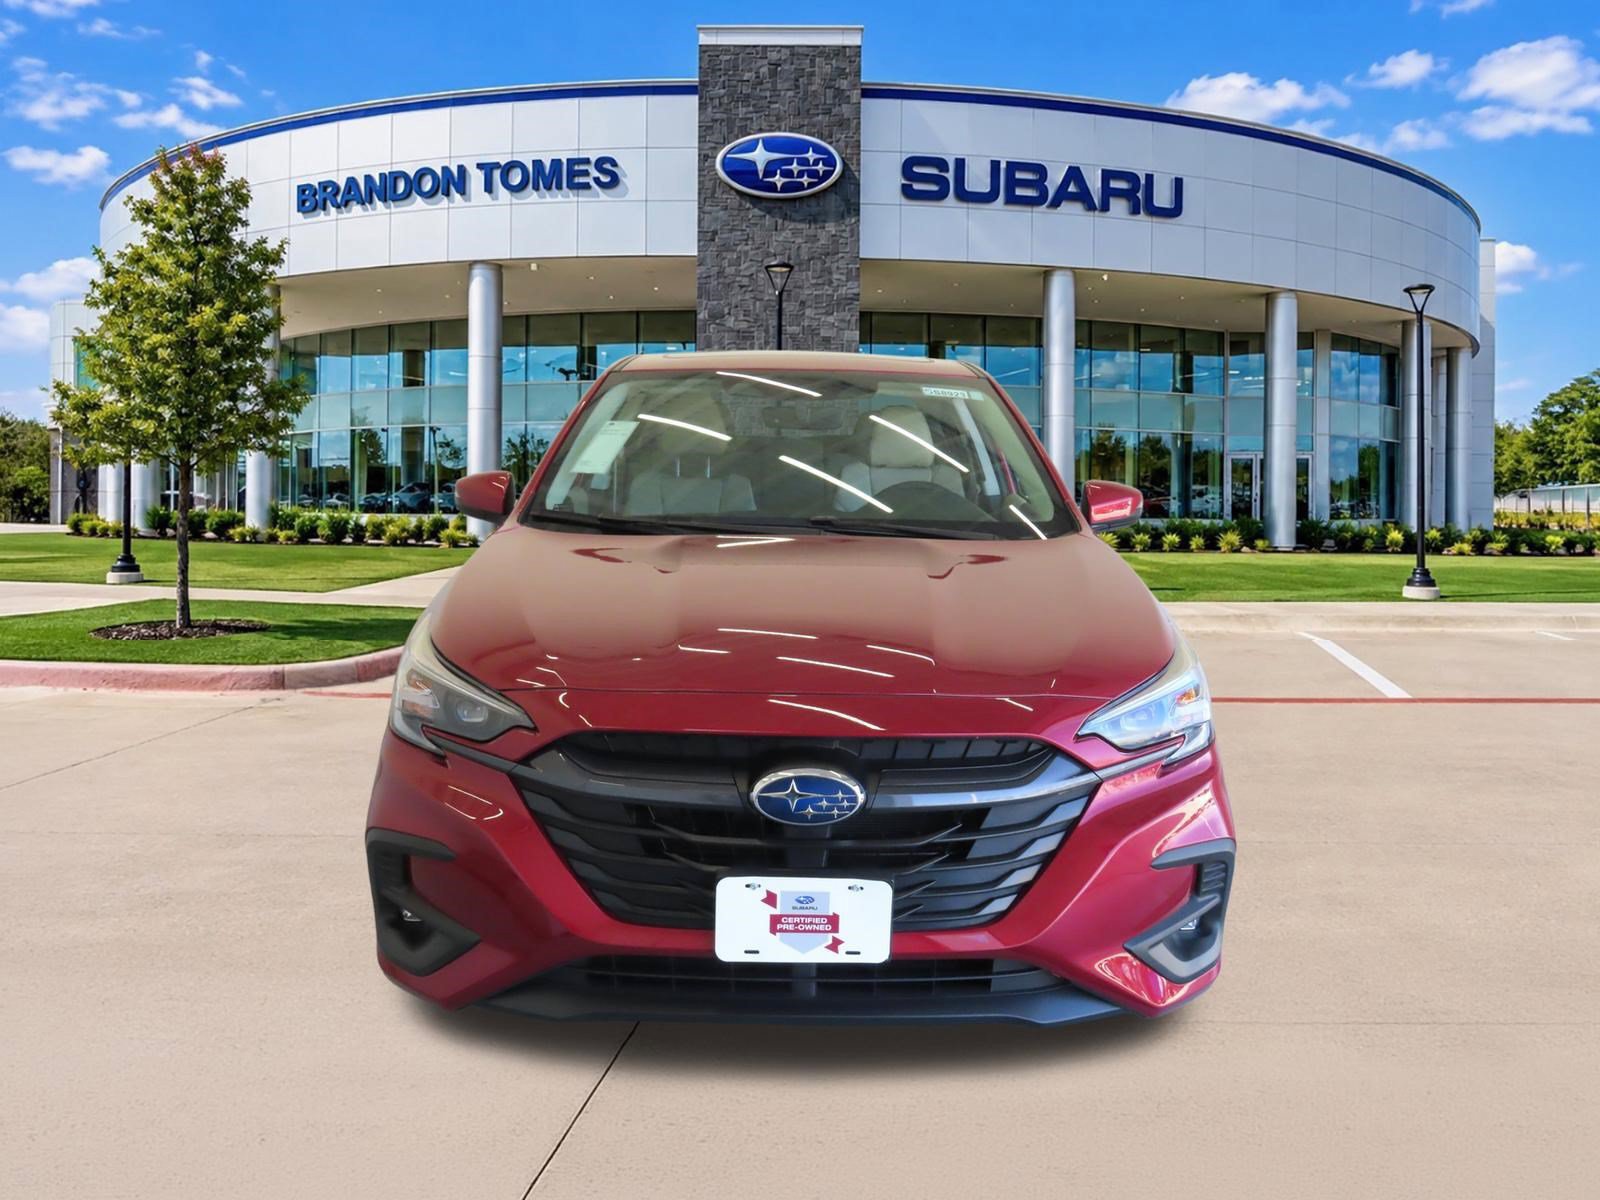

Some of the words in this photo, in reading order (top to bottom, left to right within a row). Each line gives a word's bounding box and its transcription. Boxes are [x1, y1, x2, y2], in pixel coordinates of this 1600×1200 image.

[296, 163, 467, 214] BRANDON
[476, 156, 621, 195] TOMES
[901, 155, 1184, 218] SUBARU
